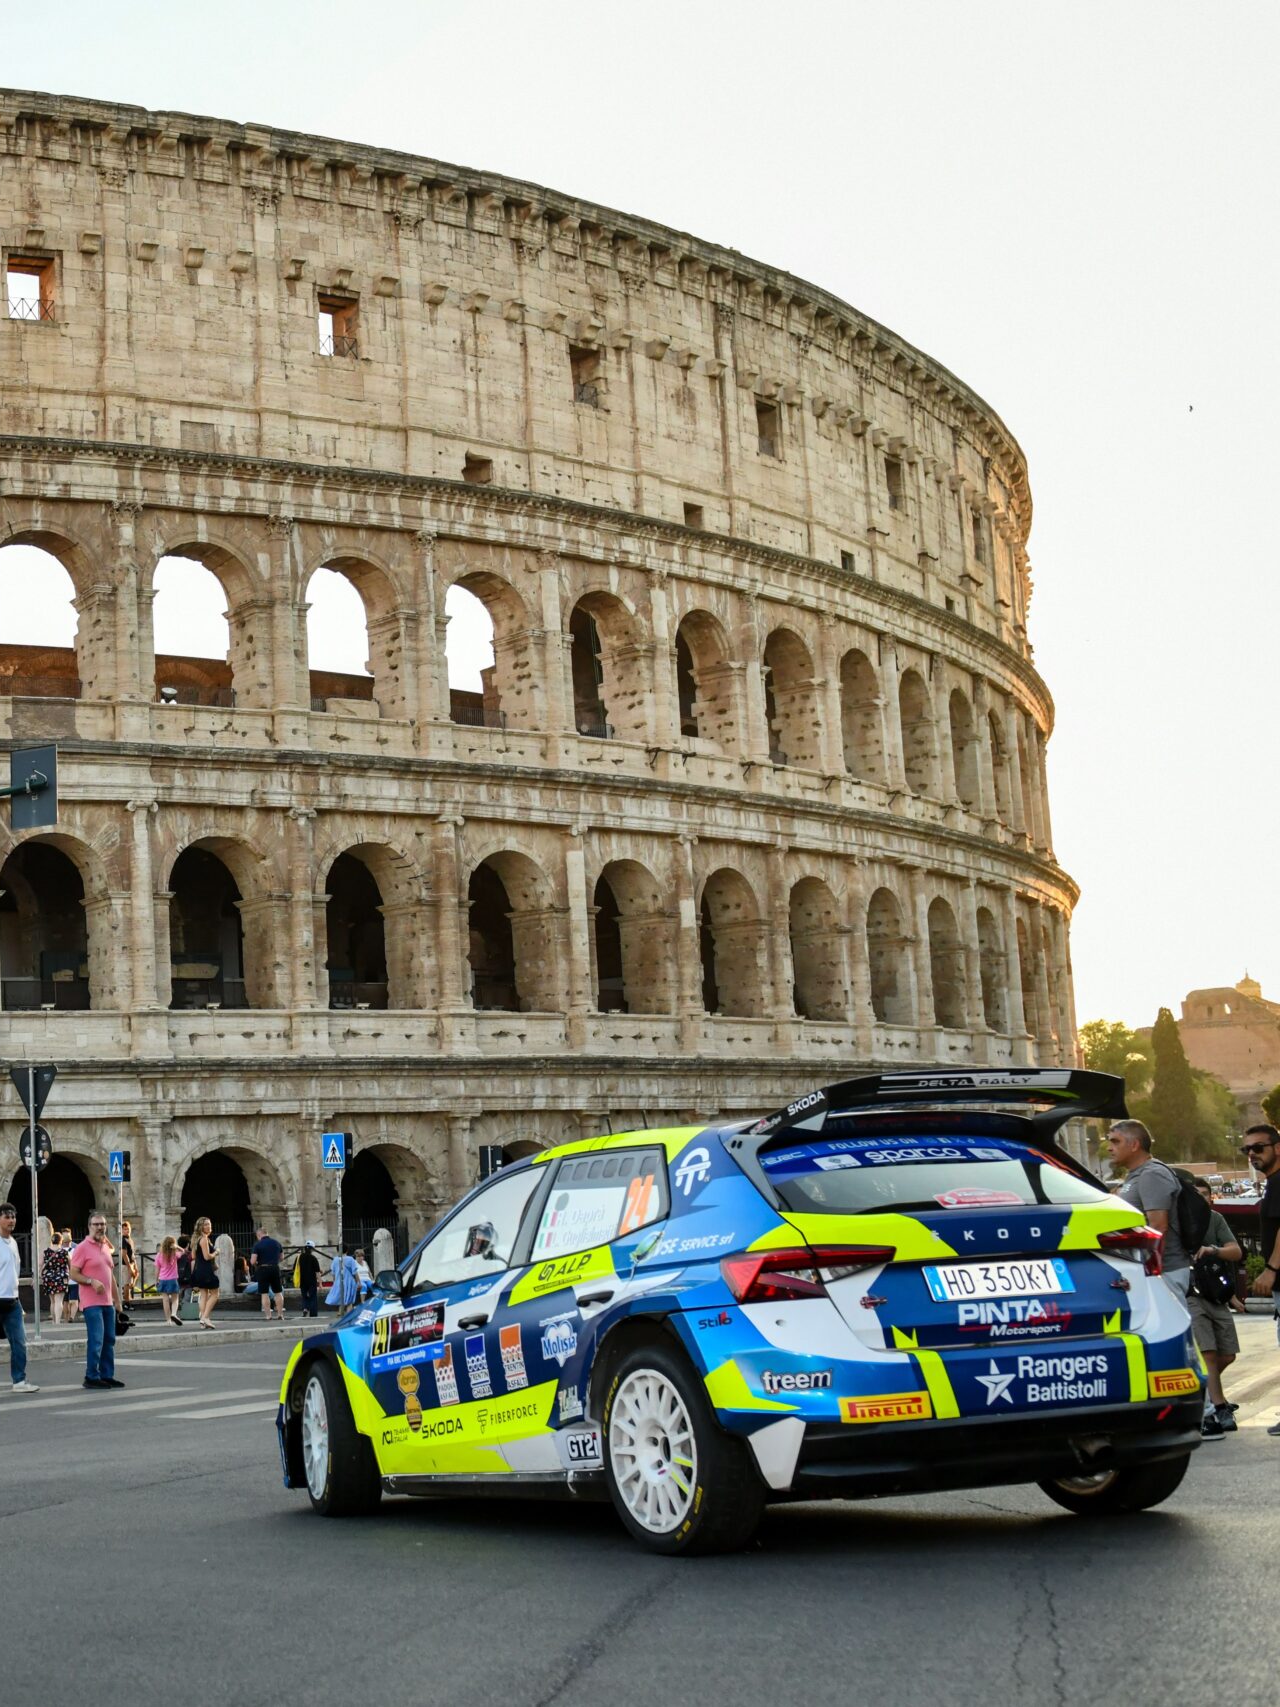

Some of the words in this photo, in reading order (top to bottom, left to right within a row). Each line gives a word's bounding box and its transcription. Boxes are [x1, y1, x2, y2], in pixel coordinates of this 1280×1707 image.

[918, 1078, 970, 1088] DELTA
[979, 1077, 1032, 1085] RALLY
[827, 1138, 879, 1151] FOLLOW
[879, 1137, 899, 1146] US
[900, 1137, 919, 1145] ON
[864, 1147, 962, 1165] sparco
[619, 1174, 655, 1236] 24
[678, 1234, 720, 1252] SERVICE
[719, 1231, 736, 1246] srl
[553, 1253, 593, 1278] ALP
[943, 1268, 977, 1297] HD
[979, 1263, 1054, 1294] 350KY
[698, 1311, 733, 1330] Stilo
[957, 1299, 1049, 1326] PINTA
[374, 1317, 388, 1356] 24
[989, 1323, 1061, 1338] Motorsport
[470, 1371, 489, 1382] TRENTIN
[504, 1361, 525, 1373] TRENTIN
[1017, 1354, 1109, 1381] Rangers
[437, 1381, 457, 1392] PADOVA
[762, 1370, 832, 1390] freem
[1026, 1378, 1108, 1403] Battistolli
[1154, 1372, 1199, 1393] PIRELLI
[490, 1403, 539, 1426] FIBERFORCE
[847, 1397, 924, 1419] PIRELLI
[567, 1431, 600, 1459] GT2i
